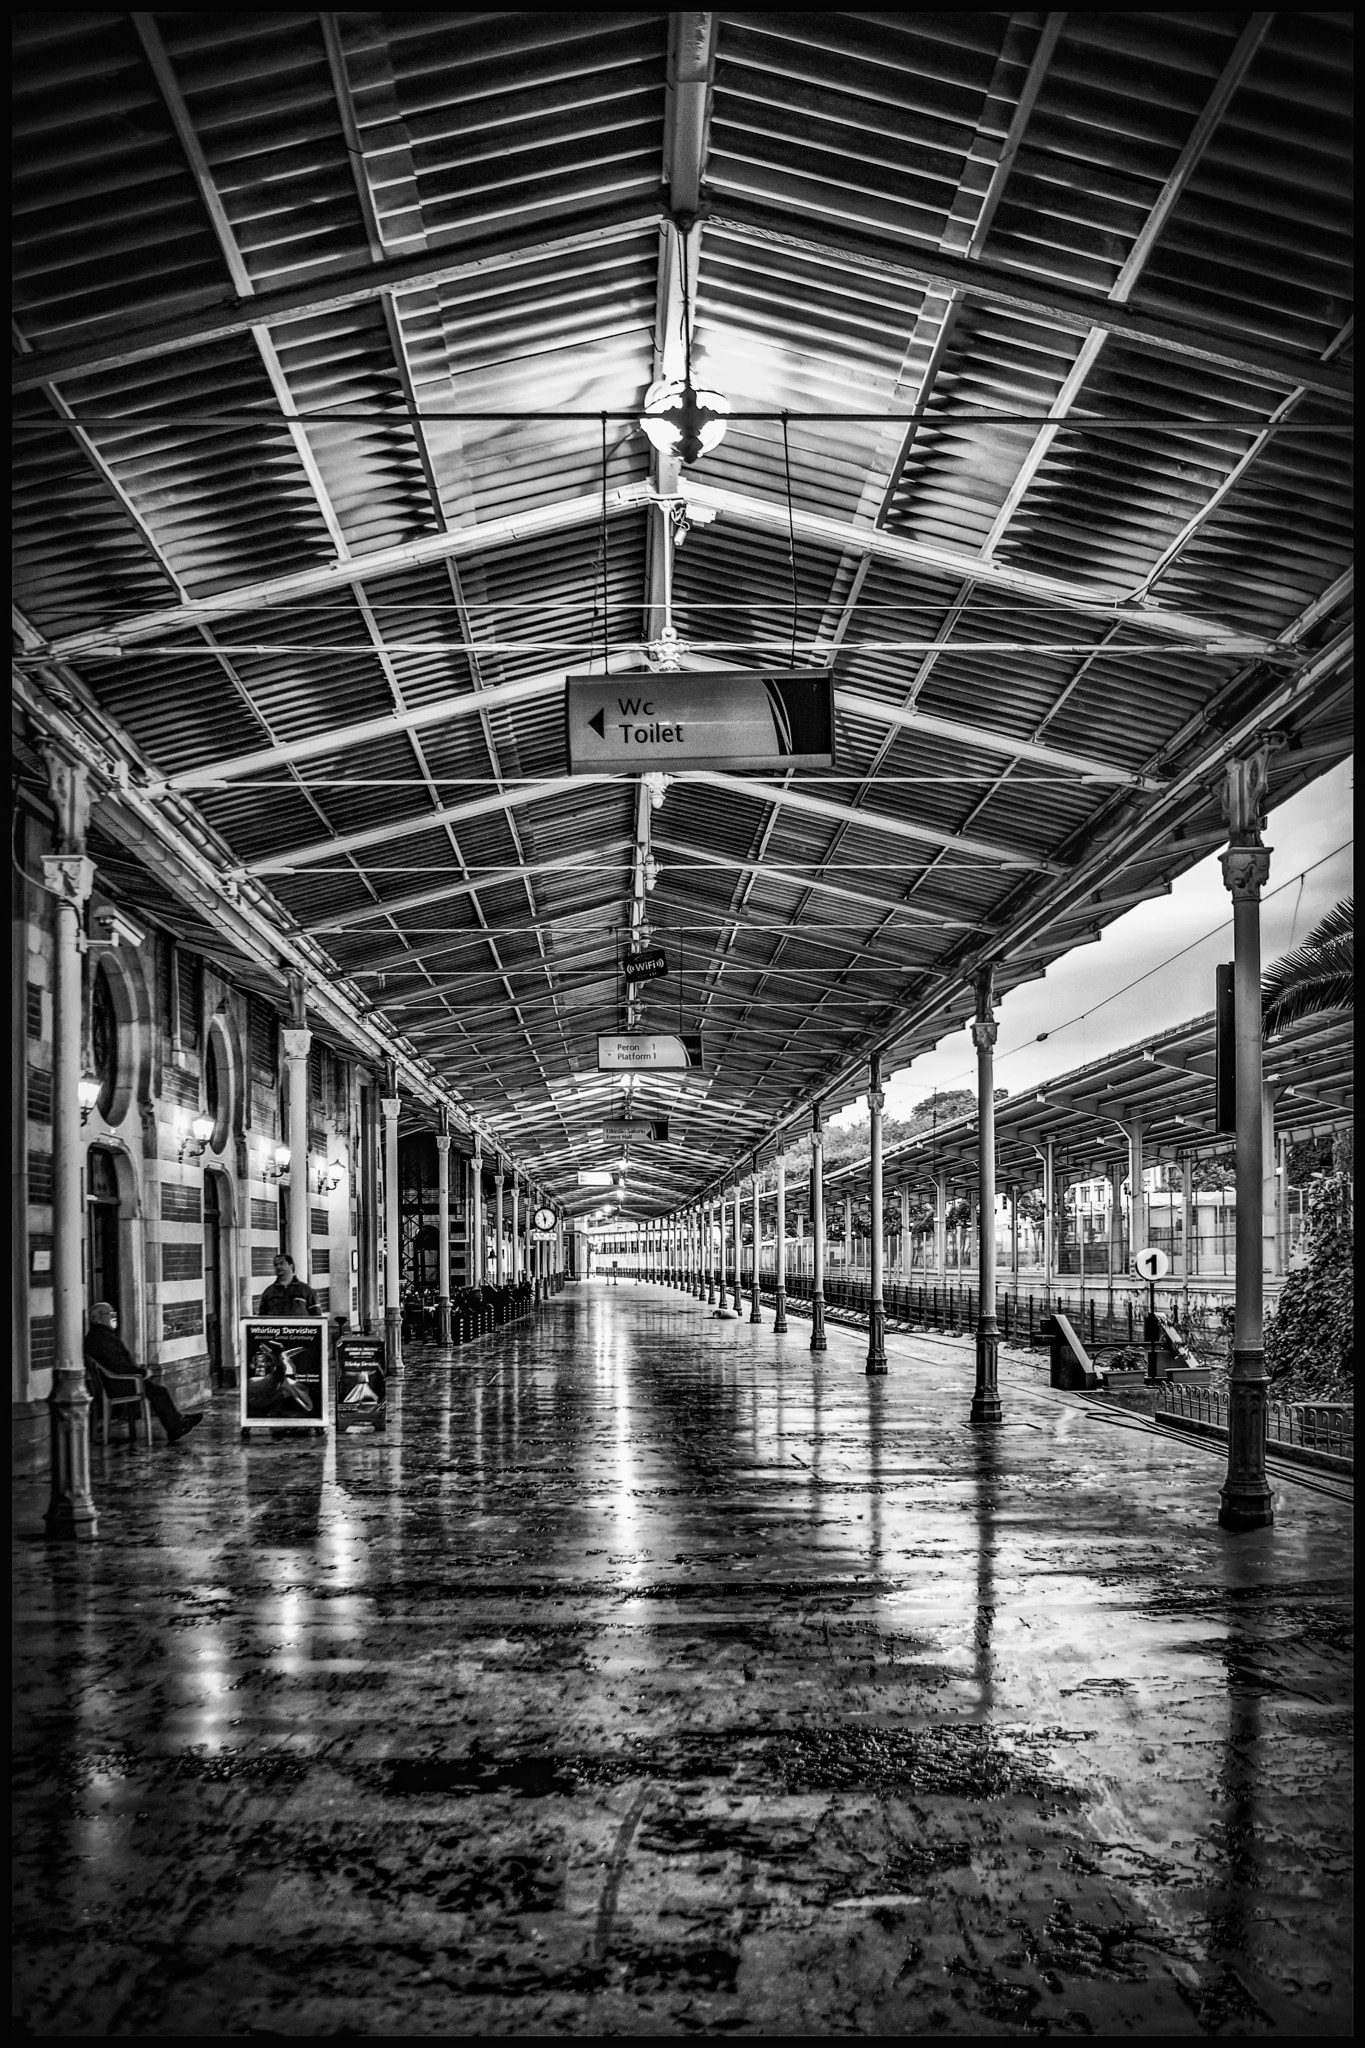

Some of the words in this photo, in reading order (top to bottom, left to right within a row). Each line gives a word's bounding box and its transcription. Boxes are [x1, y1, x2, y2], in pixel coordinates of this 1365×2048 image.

[618, 698, 654, 716] Wc
[618, 723, 684, 743] Toilet
[635, 960, 656, 971] WiFi
[617, 1043, 640, 1051] Peron
[617, 1052, 651, 1060] Platform
[653, 1052, 657, 1060] 1
[1145, 1254, 1157, 1275] 1
[250, 1326, 280, 1337] Whirling
[282, 1326, 318, 1334] Dervishes
